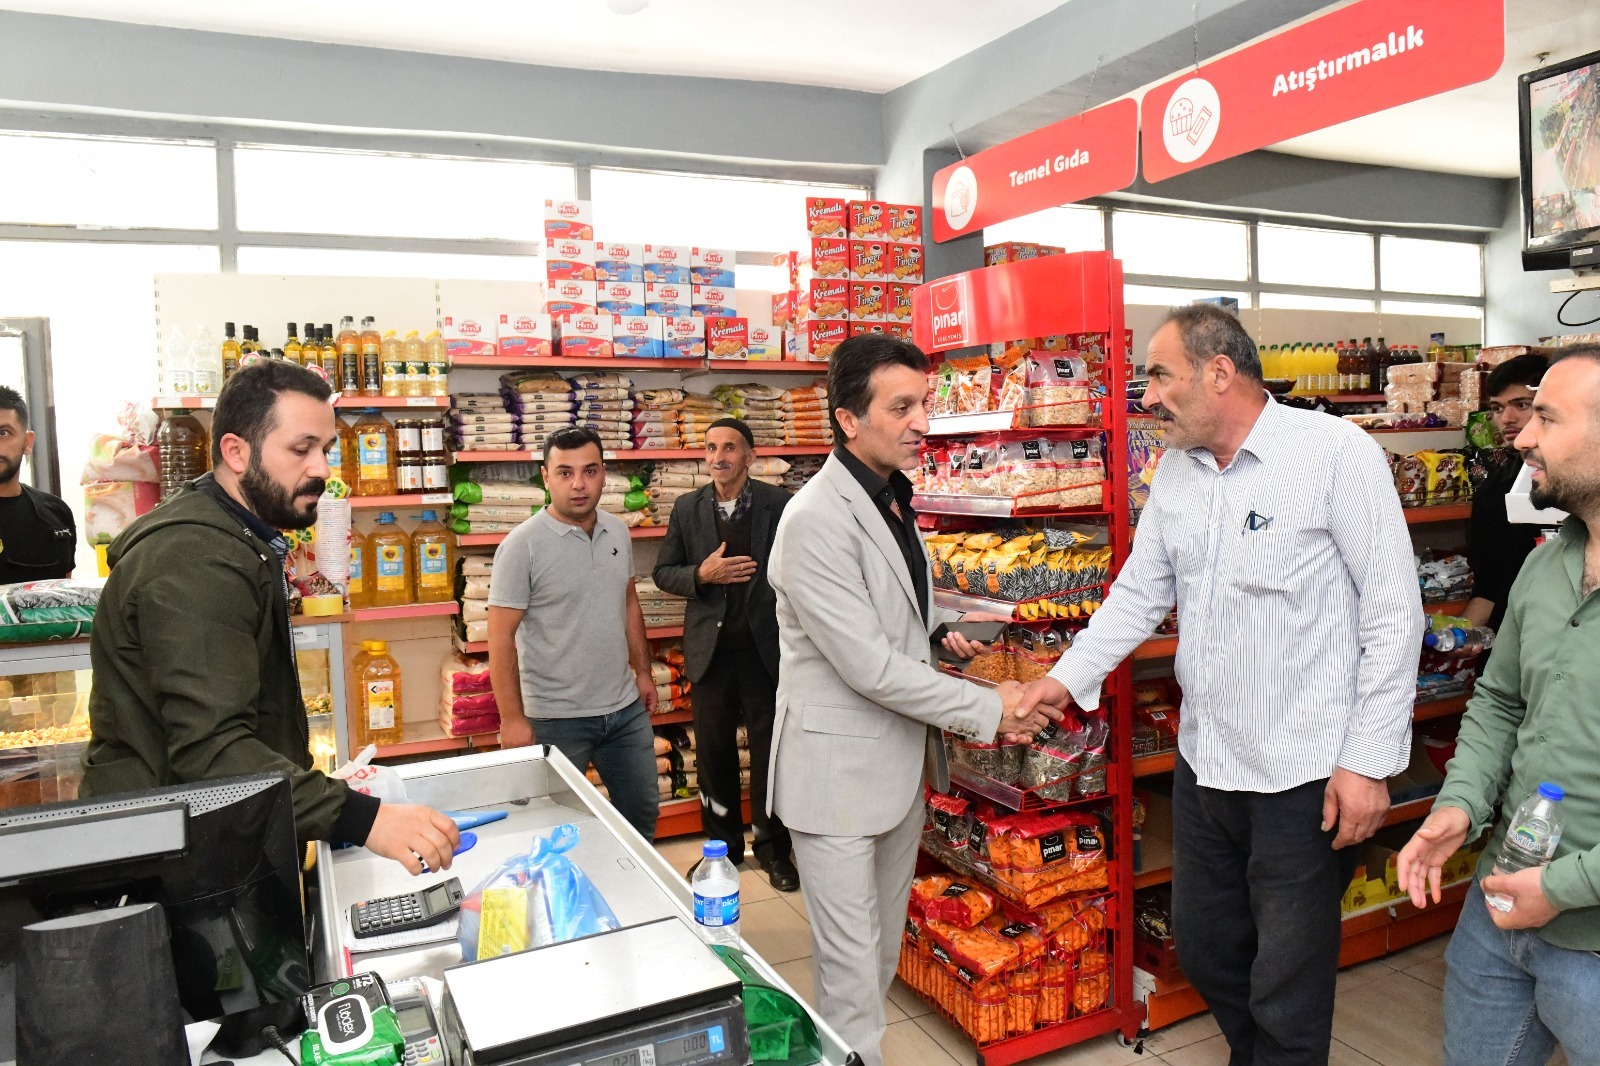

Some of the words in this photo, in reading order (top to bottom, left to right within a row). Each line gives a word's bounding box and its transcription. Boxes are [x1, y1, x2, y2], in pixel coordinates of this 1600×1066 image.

[1272, 25, 1424, 97] Atıştırmalık
[1009, 158, 1050, 188] Temel
[1053, 148, 1089, 173] Gıda
[809, 203, 842, 217] Kremalı
[854, 212, 881, 227] Finger
[889, 217, 914, 231] Finger
[814, 243, 847, 258] Kremalı
[855, 252, 881, 268] Finger
[894, 253, 919, 269] Finger
[813, 284, 846, 299] Kremalı
[854, 293, 881, 308] Finger
[710, 321, 746, 338] Kremalı
[811, 325, 845, 340] Kremalı
[361, 974, 373, 987] 72
[710, 1035, 723, 1045] TL
